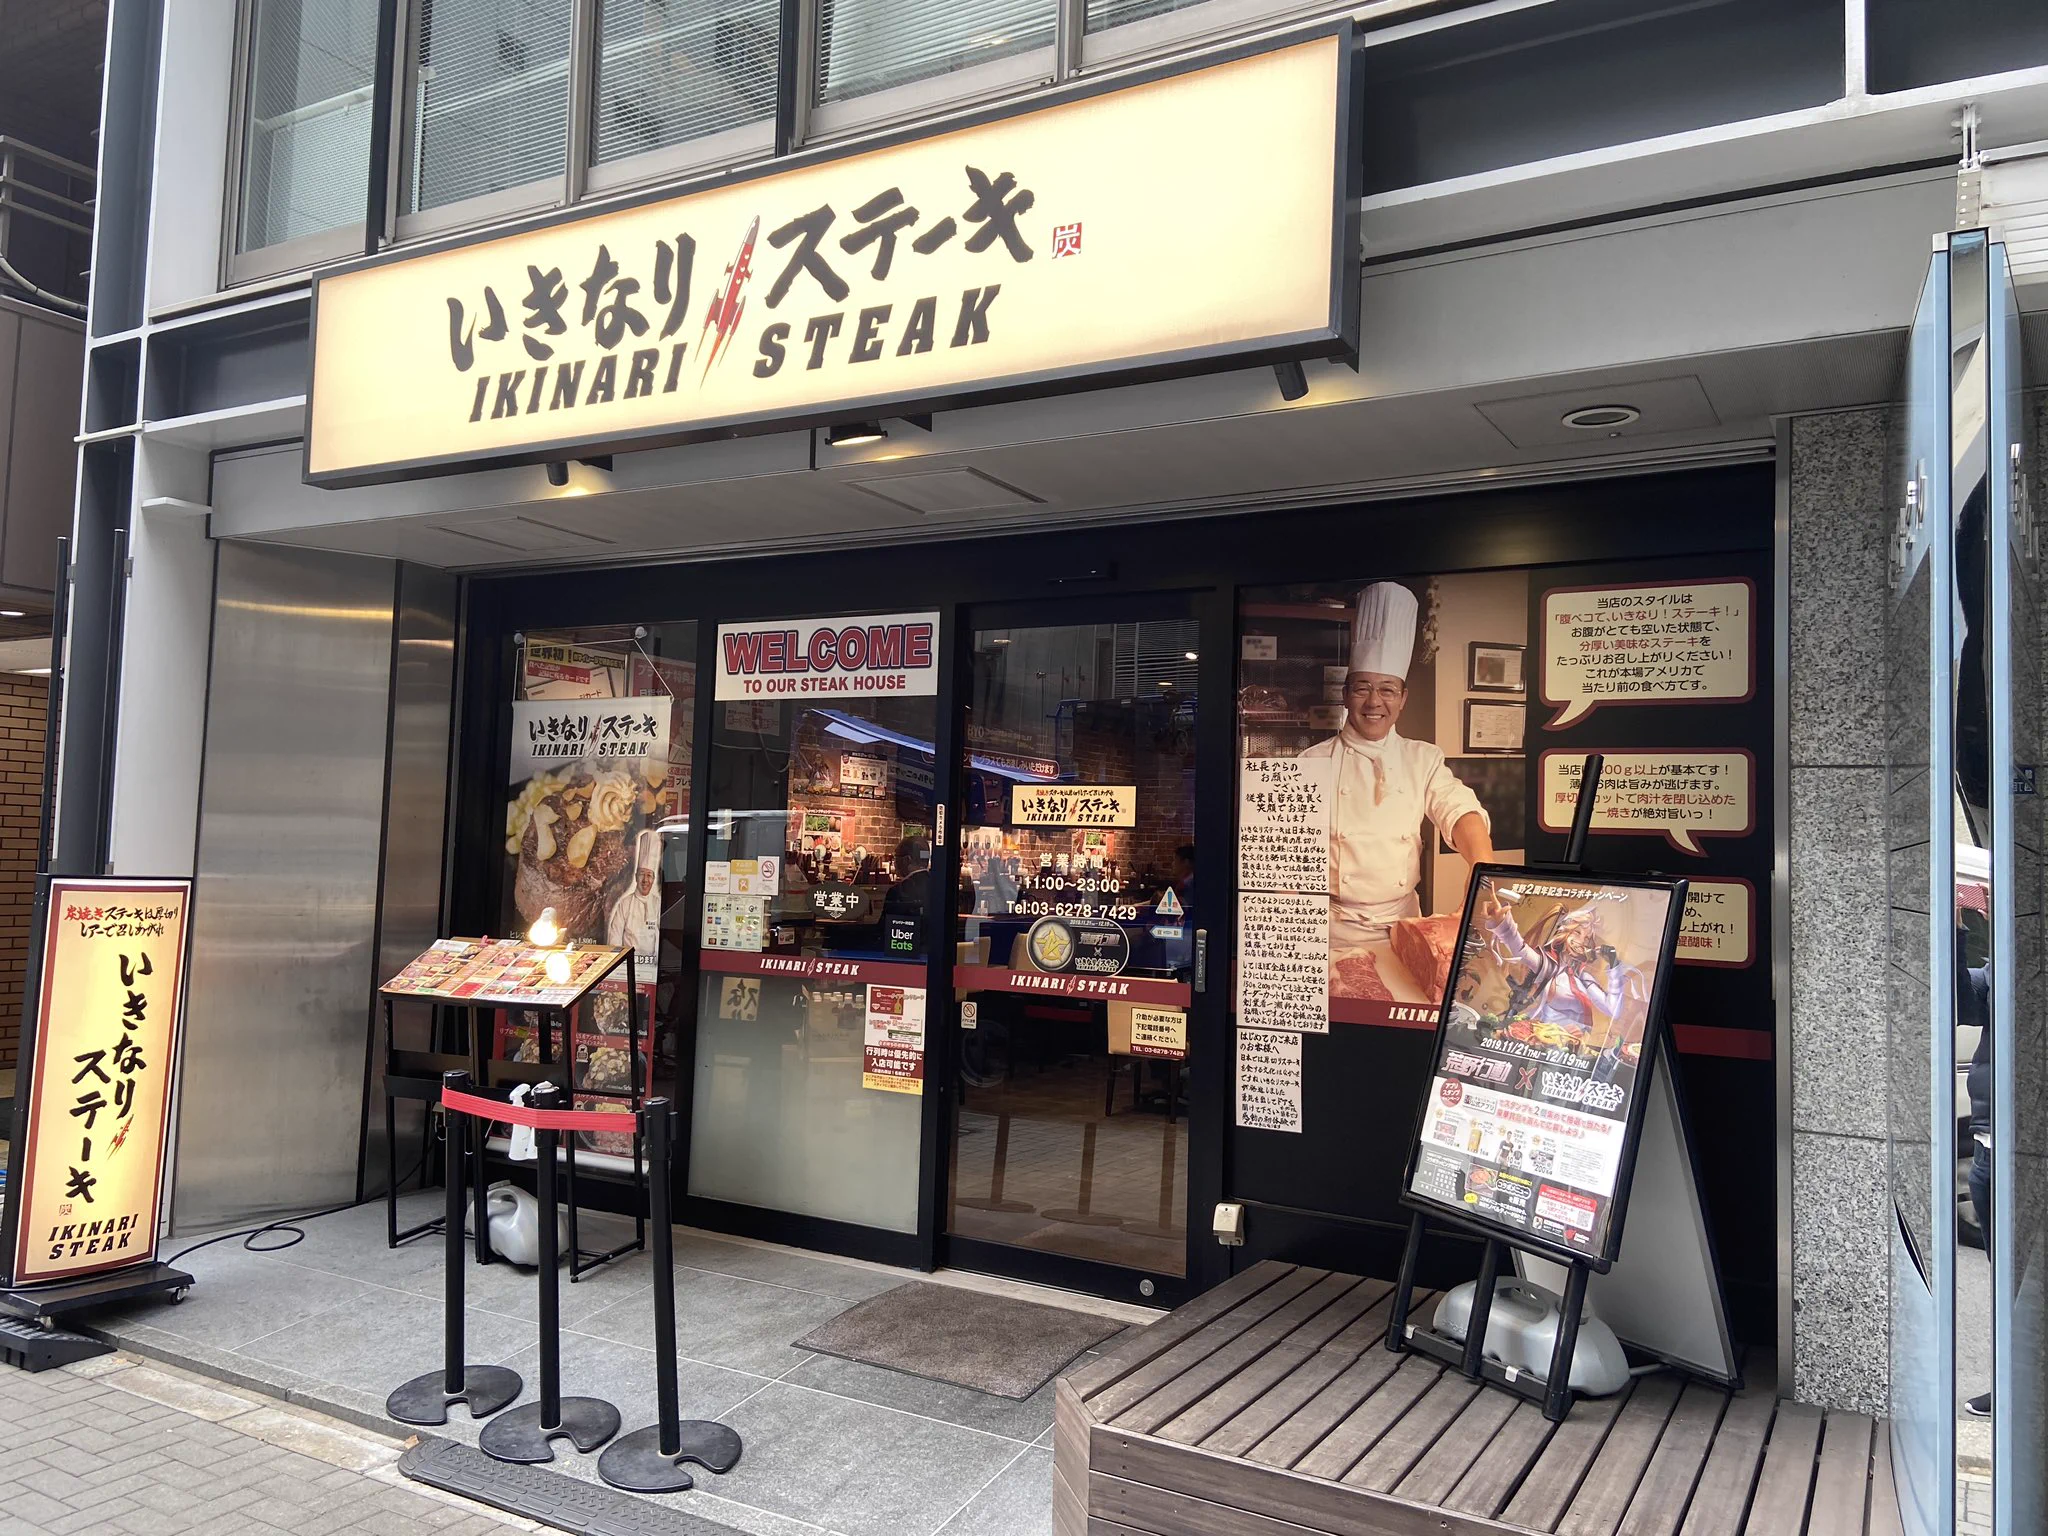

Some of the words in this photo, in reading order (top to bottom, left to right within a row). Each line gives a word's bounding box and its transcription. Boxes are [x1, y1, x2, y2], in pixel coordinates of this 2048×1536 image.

[447, 232, 696, 373] いきなり
[764, 164, 1035, 309] ステーキ
[468, 342, 688, 423] IKINARI
[752, 283, 1002, 379] STEAK
[1597, 593, 1693, 608] 当店のスタイルは
[1571, 621, 1720, 638] お腹がとても空いた状態で、
[723, 623, 932, 675] WELCOME
[1579, 636, 1711, 652] 分厚い美味なステーキを
[1557, 649, 1732, 666] たっぷりお召し上がりください！
[1585, 665, 1705, 678] これが本場アメリカで
[744, 680, 762, 693] TO
[766, 678, 797, 692] OUR
[800, 676, 848, 692] STEAK
[853, 675, 906, 690] HOUSE
[1582, 680, 1708, 694] 当たり前の食べ方です。
[529, 714, 588, 742] いきなり
[602, 713, 657, 740] ステーキ
[532, 743, 584, 756] IKINARI
[599, 742, 648, 756] STEAK
[1569, 778, 1720, 790] 薄お肉は旨みが逃げます。
[1021, 797, 1069, 814] いきなり
[1079, 797, 1120, 813] ステーキ
[1026, 813, 1067, 822] IKINARI
[1077, 814, 1116, 823] STEAK
[1039, 852, 1104, 869] 営業時間
[813, 890, 860, 909] 営業中
[1006, 900, 1137, 920] Tel:03-6278-7429
[891, 929, 914, 940] Uber
[891, 940, 913, 951] Eats
[760, 958, 807, 972] IKINARI
[816, 960, 860, 976] STEAK
[1010, 975, 1066, 990] IKINARI
[1077, 979, 1130, 995] STEAK
[1136, 1013, 1183, 1024] 介助が必要な方は
[113, 952, 153, 1120] いきなり
[1136, 1023, 1177, 1033] 下記電話番号へ
[1136, 1033, 1179, 1043] ご連絡ください。
[865, 1046, 922, 1061] 行列時は優先的に
[871, 1057, 916, 1071] 入店可能です
[1541, 1071, 1583, 1092] いきなり
[1587, 1080, 1625, 1102] ステーキ
[1541, 1087, 1577, 1100] IKINARI
[1582, 1095, 1617, 1110] STEAK
[65, 1047, 112, 1204] ステーキ
[48, 1213, 139, 1242] IKINARI
[48, 1233, 132, 1260] STEAK
